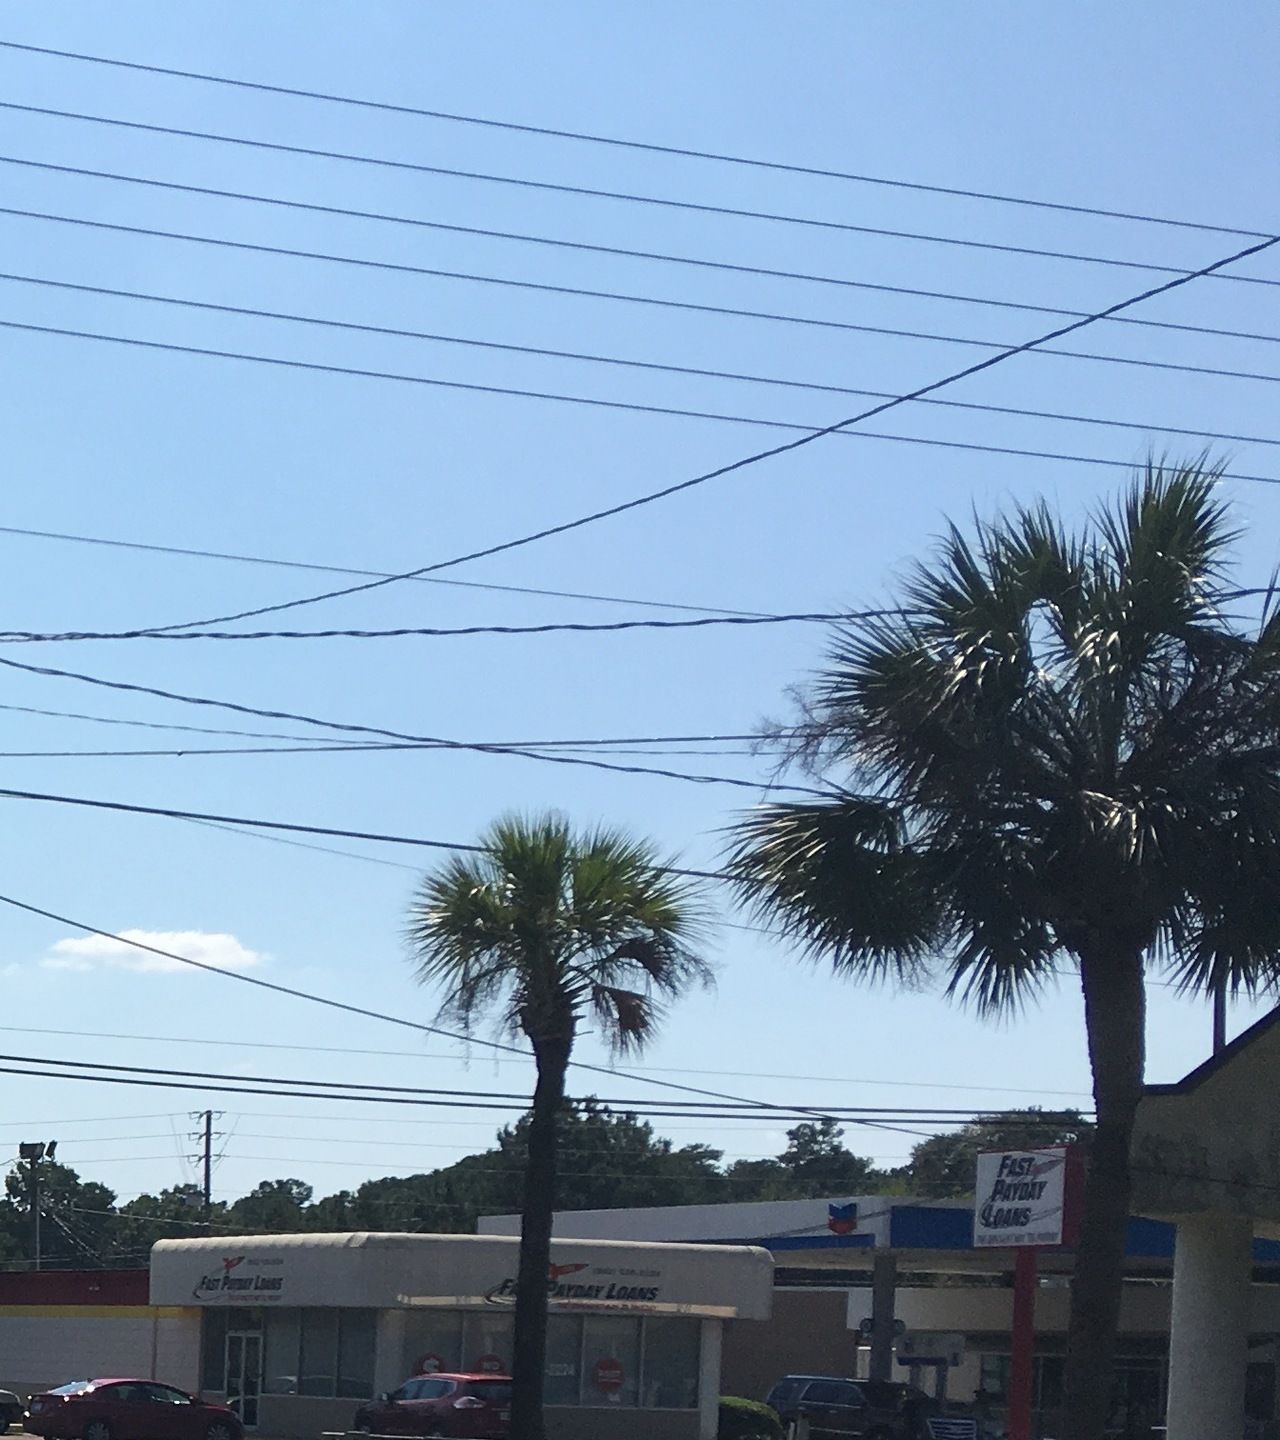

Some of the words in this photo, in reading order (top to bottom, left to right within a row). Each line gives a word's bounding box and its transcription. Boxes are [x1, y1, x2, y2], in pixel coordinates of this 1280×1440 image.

[997, 1154, 1036, 1178] FAST
[991, 1179, 1048, 1202] PAYDAY
[980, 1202, 1032, 1229] LOANS
[605, 1282, 662, 1301] LOANS
